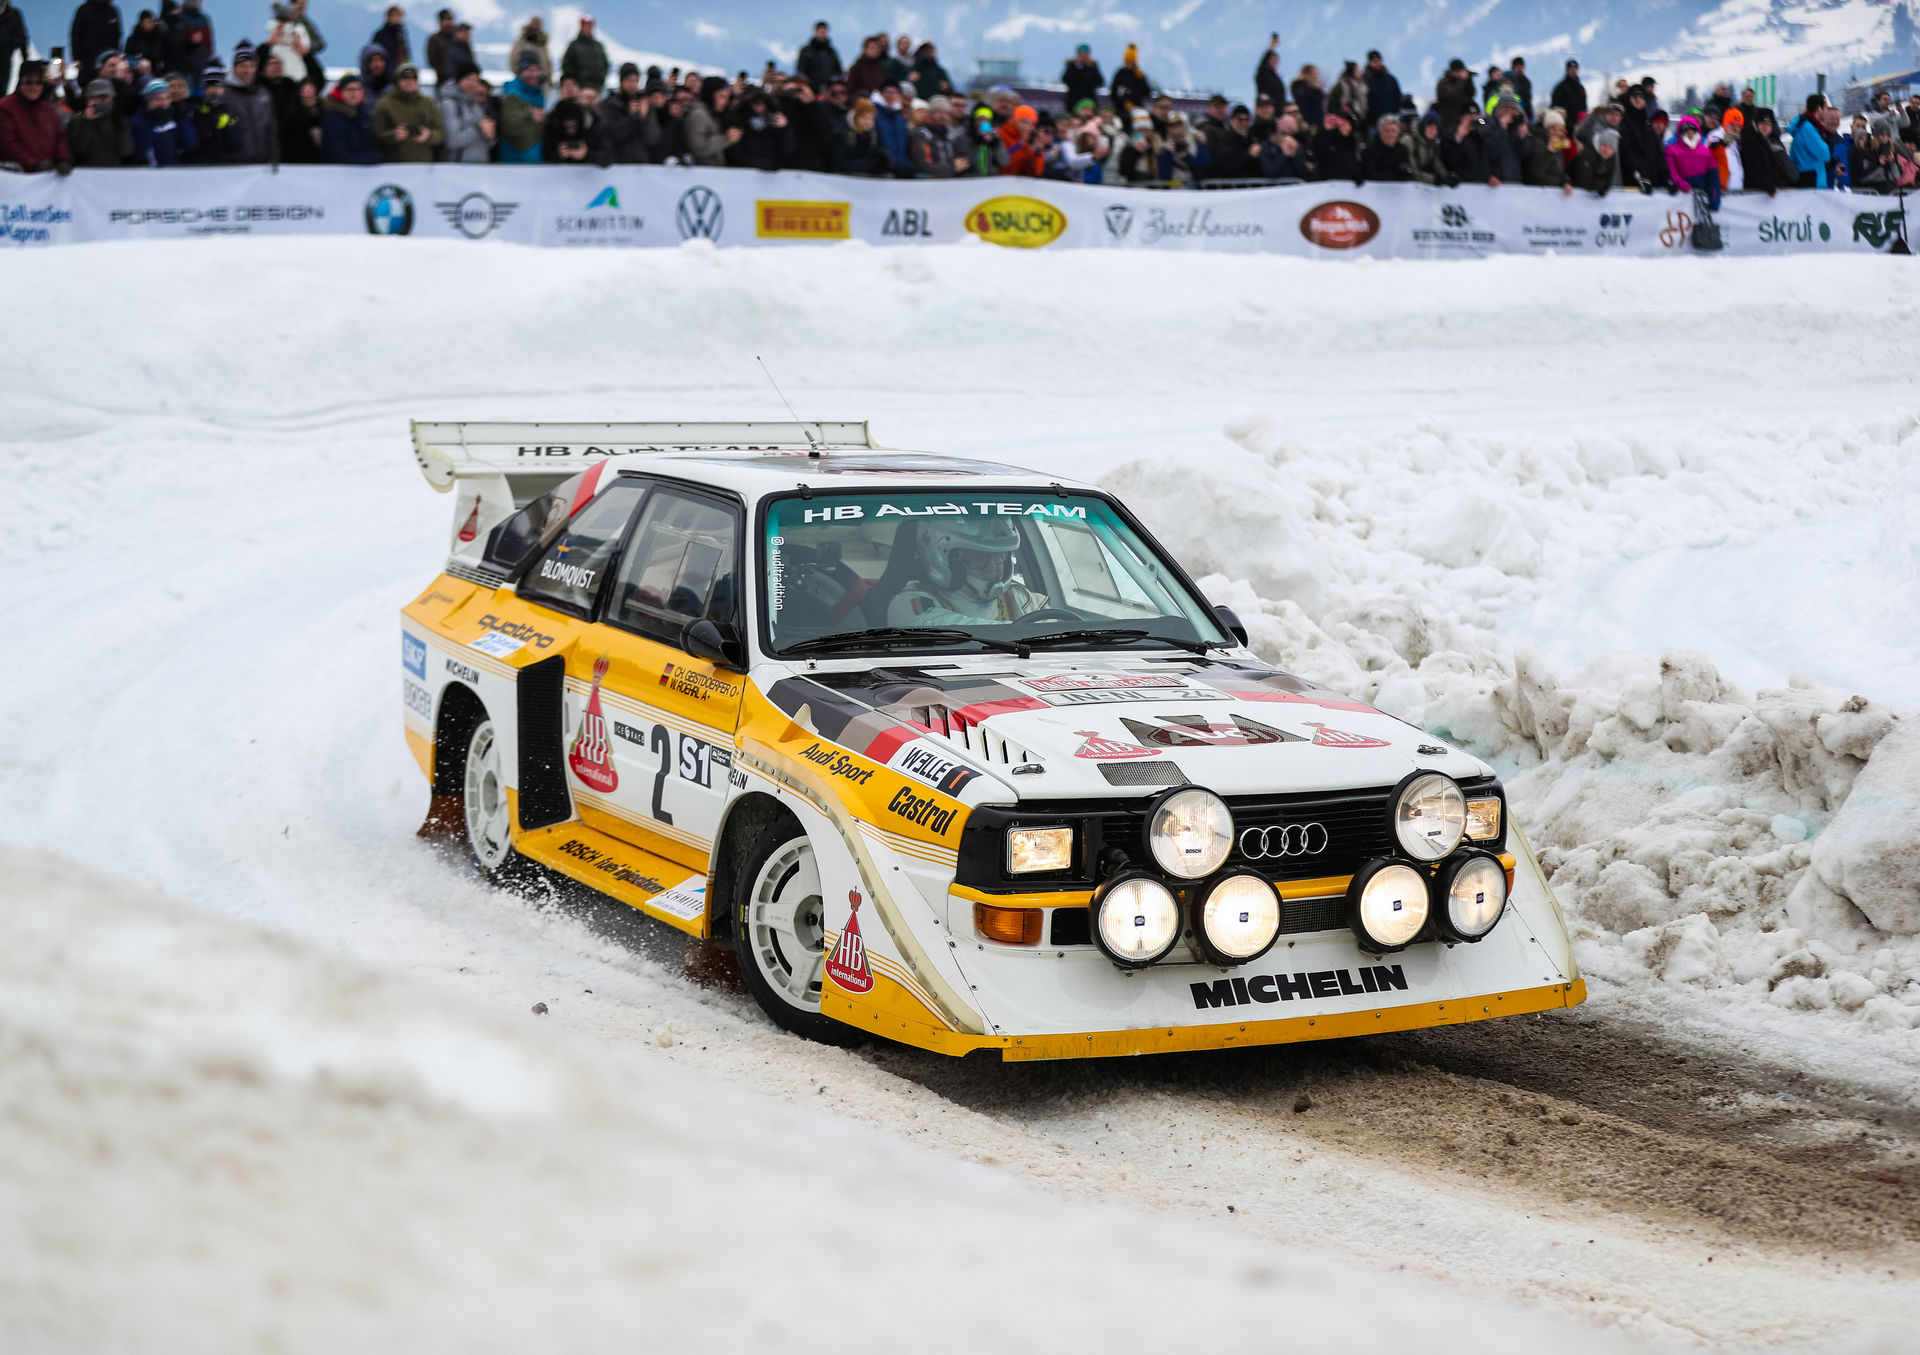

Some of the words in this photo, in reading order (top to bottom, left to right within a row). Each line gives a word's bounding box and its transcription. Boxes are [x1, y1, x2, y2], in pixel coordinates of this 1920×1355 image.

[109, 208, 229, 224] PORSCHE
[234, 205, 326, 221] DESIGN
[763, 208, 843, 232] PIRELLI
[881, 208, 933, 237] ABL
[991, 211, 1054, 233] RAUCH
[1759, 214, 1812, 242] skruf
[1595, 231, 1630, 248] OMV
[517, 446, 572, 457] HB
[804, 504, 865, 524] HB
[876, 502, 969, 517] Audi
[972, 502, 1087, 520] TEAM
[540, 559, 597, 590] BLOMQVIST
[772, 549, 786, 611] auditradition
[478, 614, 555, 649] quattro
[446, 658, 480, 685] MICHELIN
[1060, 691, 1159, 703] IN-NL
[1173, 690, 1214, 699] 24
[580, 709, 608, 766] HB
[1082, 742, 1135, 754] HB
[651, 724, 674, 826] 2
[680, 737, 711, 785] S1
[797, 743, 839, 767] Audi
[829, 755, 876, 786] Sport
[887, 785, 958, 837] Castrol
[558, 839, 605, 864] BOSCH
[593, 857, 628, 874] fuel
[612, 864, 667, 895] injection
[838, 929, 864, 972] HB
[831, 964, 867, 989] international
[1189, 964, 1409, 1010] MICHELIN
